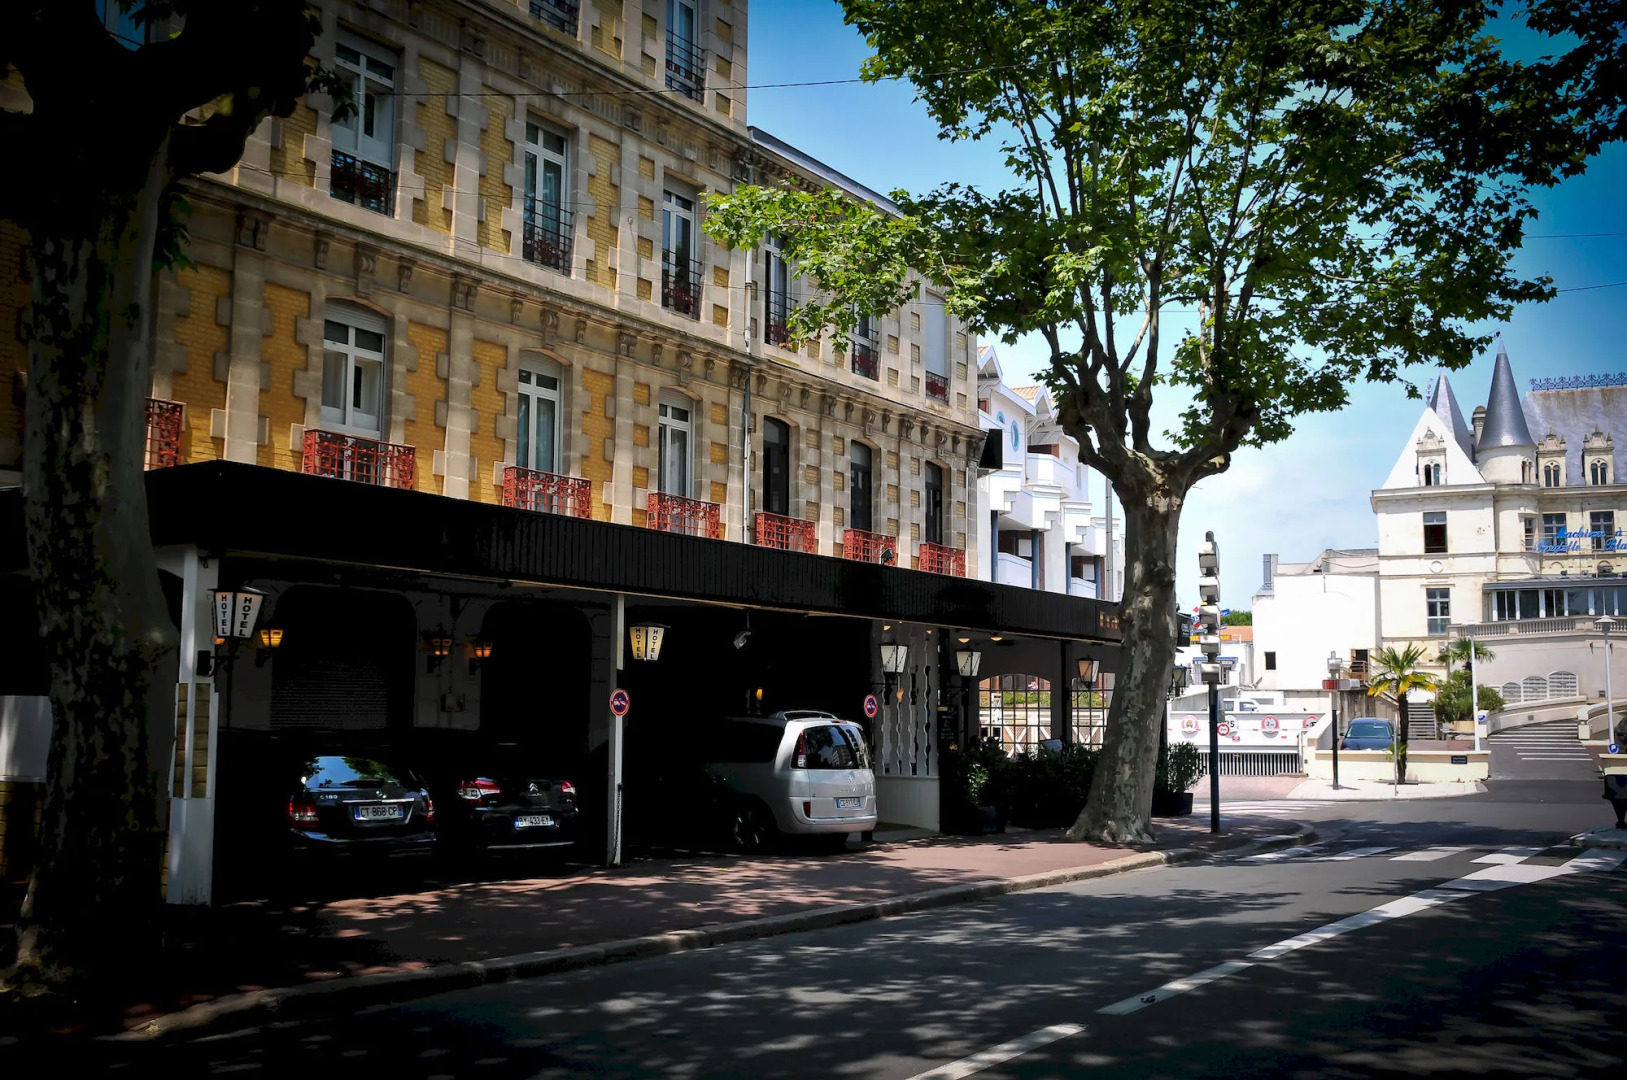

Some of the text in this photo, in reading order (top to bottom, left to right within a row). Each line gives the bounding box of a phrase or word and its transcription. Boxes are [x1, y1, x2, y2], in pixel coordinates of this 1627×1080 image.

[1553, 526, 1606, 539] Machines
[238, 596, 253, 637] HOTEL
[650, 628, 659, 660] HOTEL
